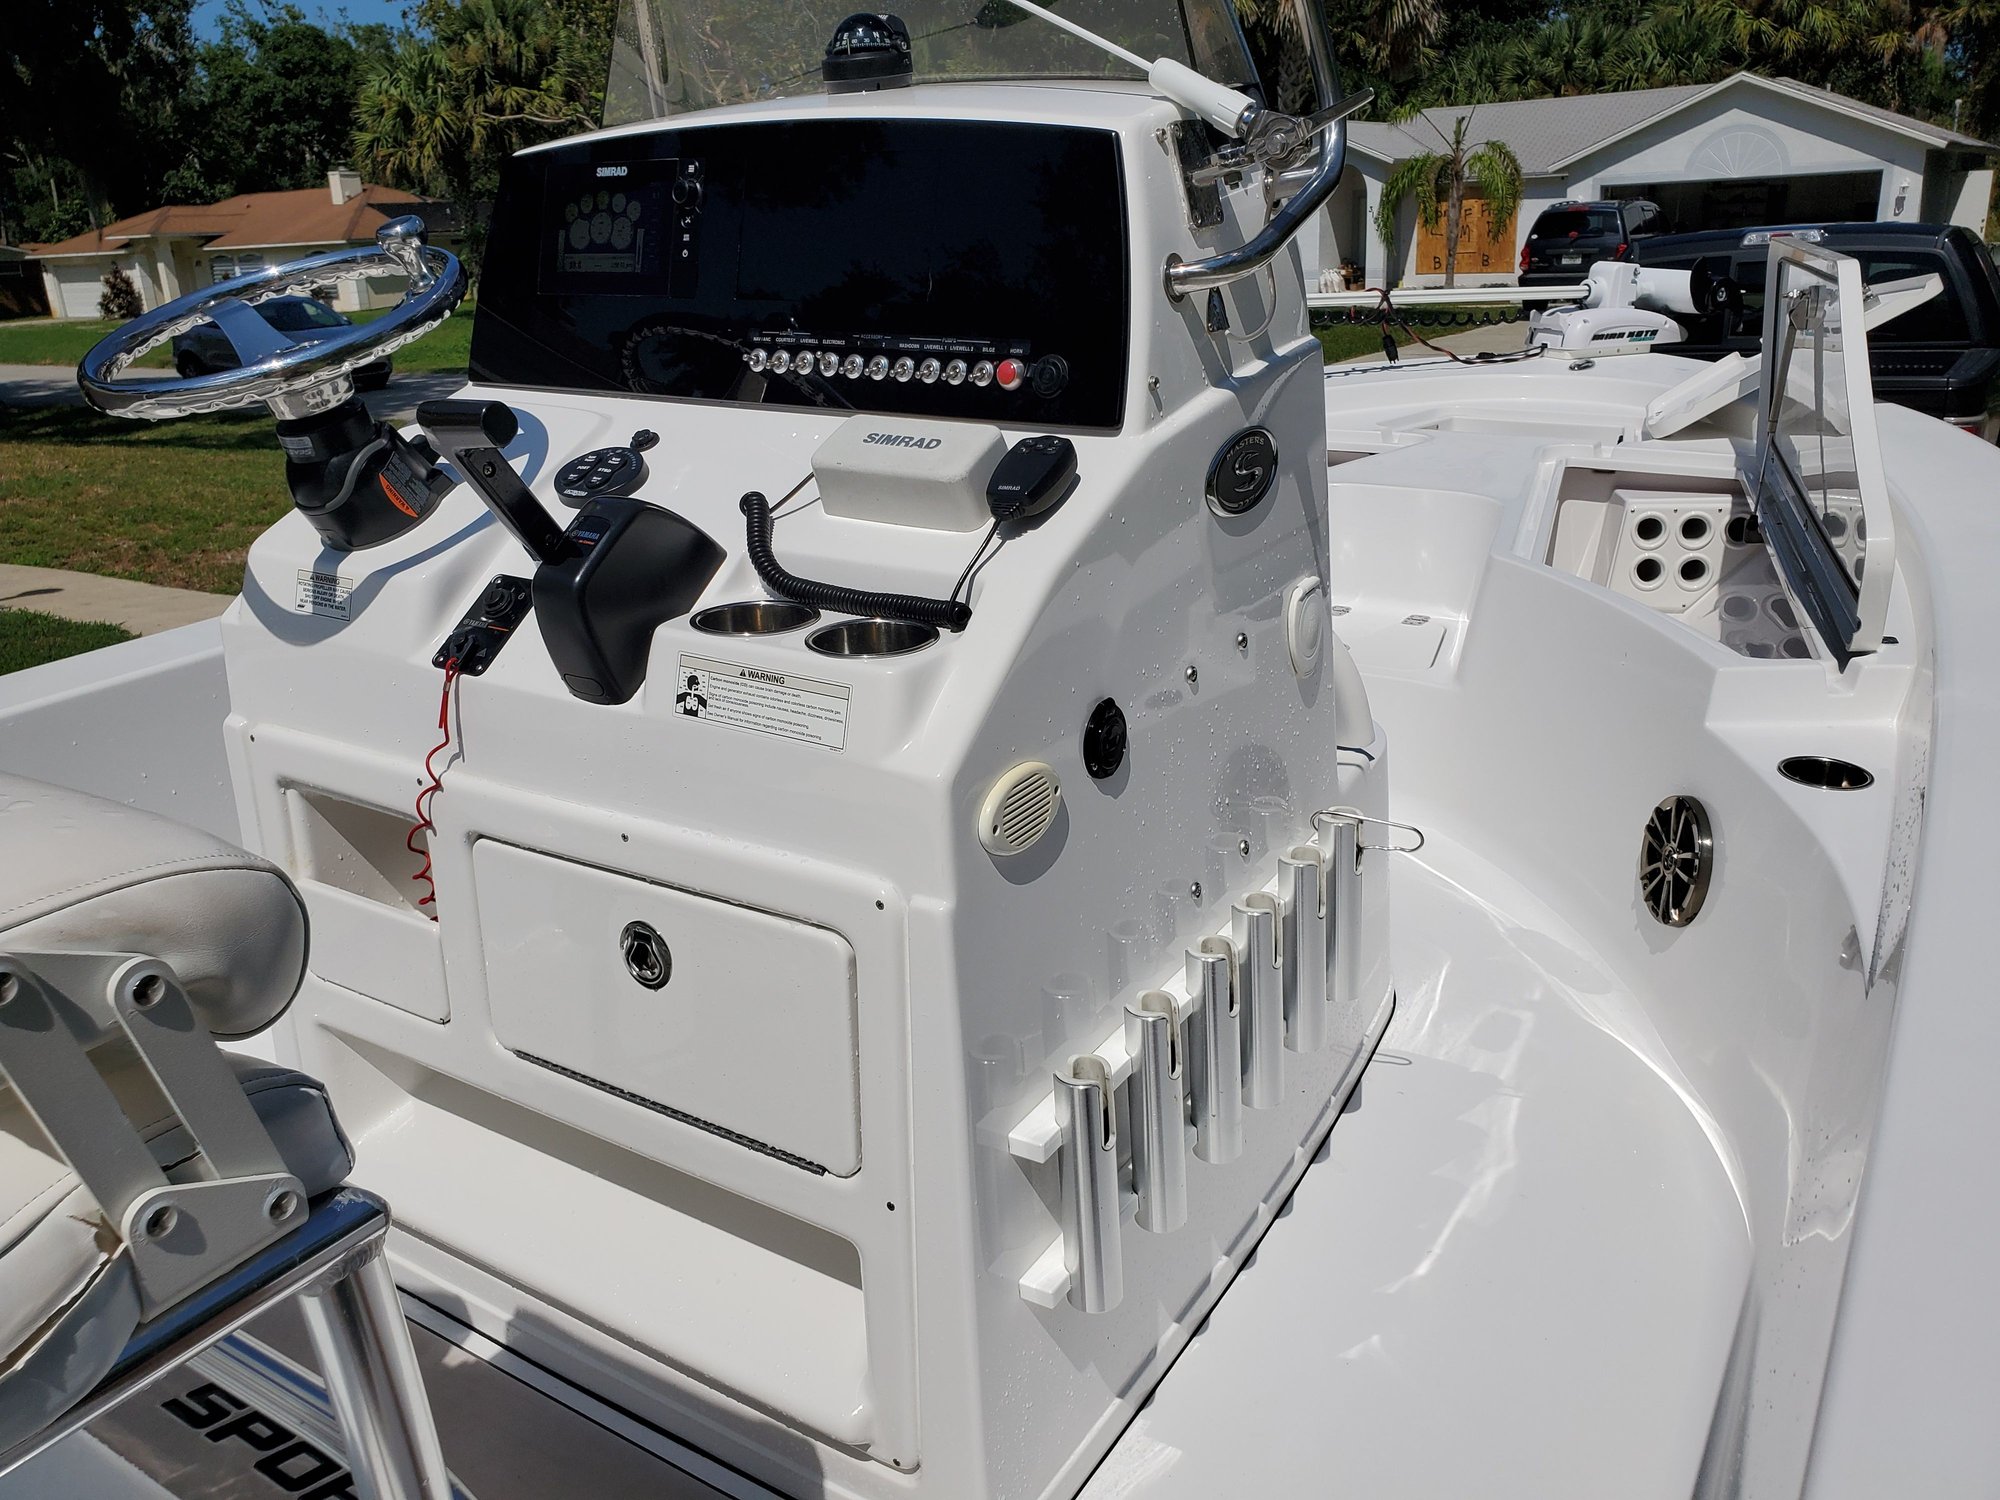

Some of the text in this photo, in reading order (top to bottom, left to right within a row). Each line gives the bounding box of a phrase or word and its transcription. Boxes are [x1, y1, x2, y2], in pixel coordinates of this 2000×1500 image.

[596, 166, 628, 177] SIMRAD
[1434, 256, 1442, 270] B
[1482, 253, 1490, 266] B
[1626, 329, 1659, 338] KOTA
[862, 432, 942, 450] SIMRAD
[1226, 436, 1266, 461] MASTERS
[385, 484, 406, 508] WARNING
[578, 530, 600, 540] YAMAHA
[315, 574, 340, 585] WARNING
[748, 670, 785, 684] WARNING
